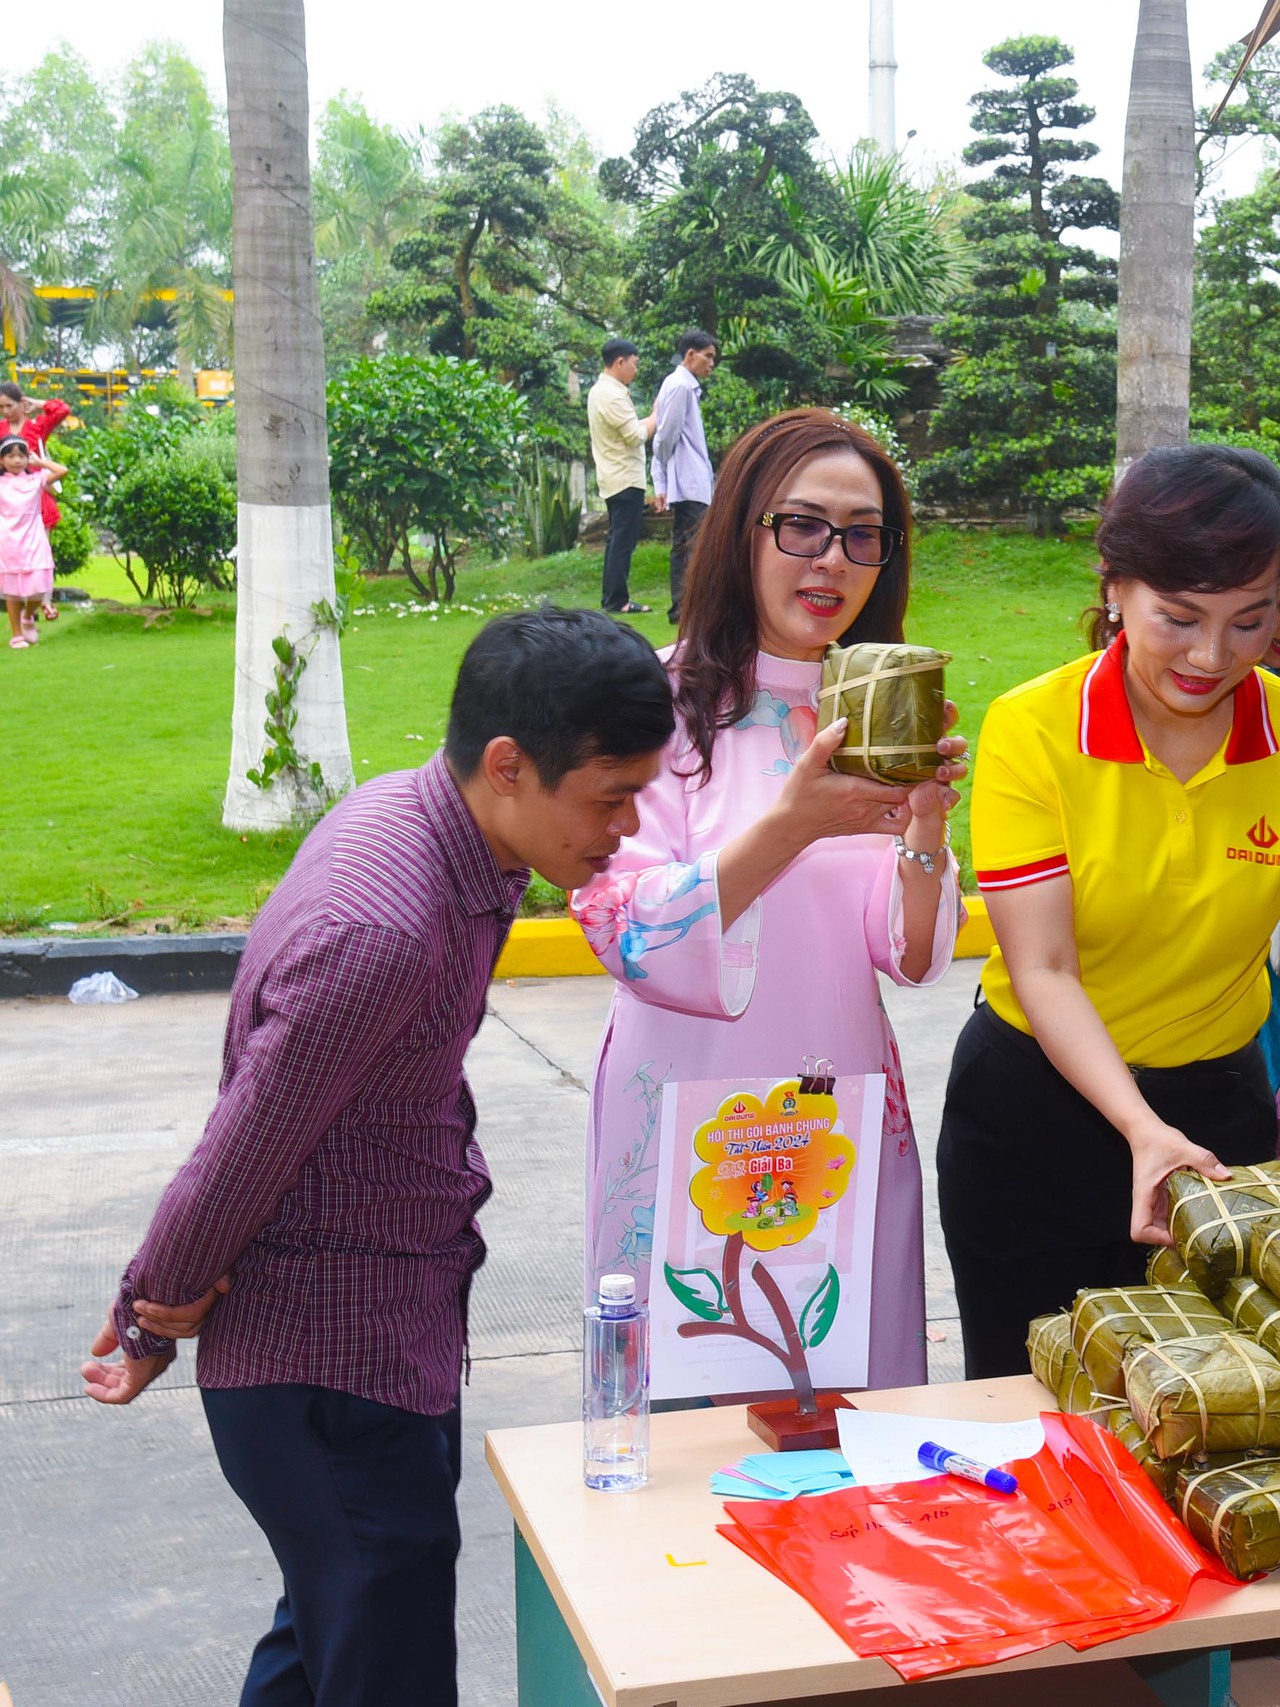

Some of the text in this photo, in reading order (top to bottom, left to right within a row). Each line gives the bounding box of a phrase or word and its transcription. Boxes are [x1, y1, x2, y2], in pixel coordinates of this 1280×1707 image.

[728, 1127, 744, 1140] THI
[774, 1132, 810, 1150] 2024
[777, 1157, 792, 1171] Ba
